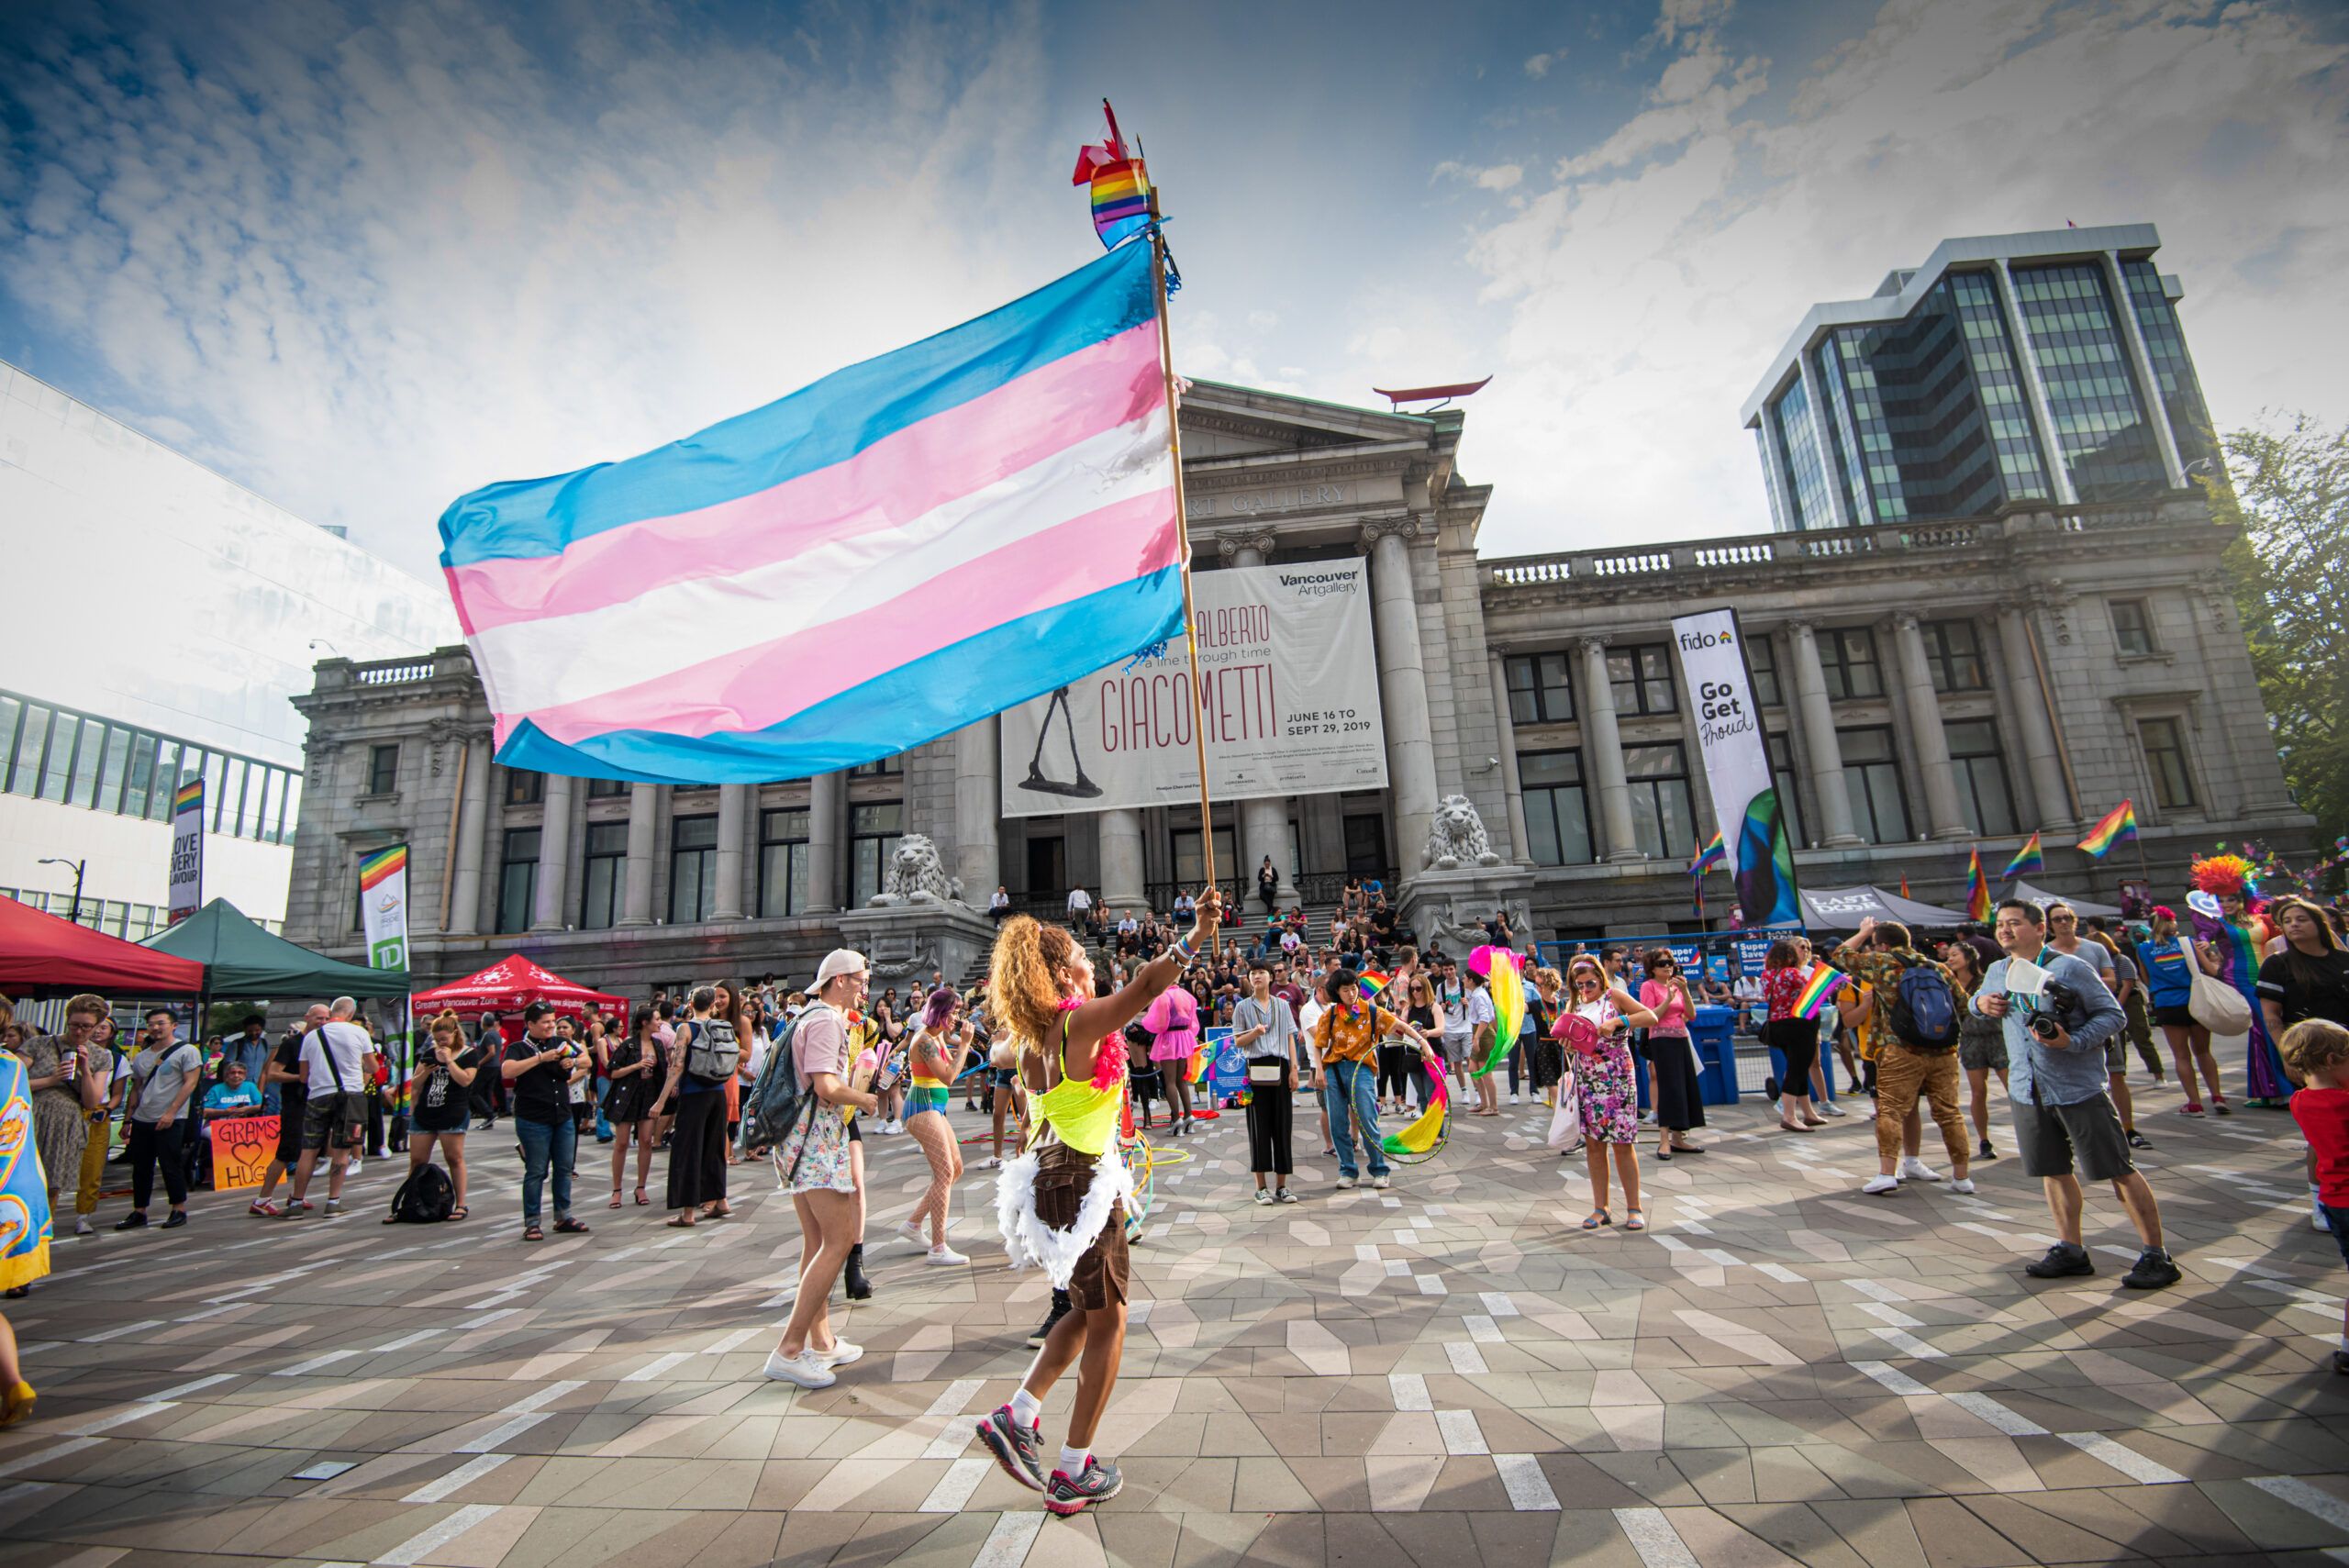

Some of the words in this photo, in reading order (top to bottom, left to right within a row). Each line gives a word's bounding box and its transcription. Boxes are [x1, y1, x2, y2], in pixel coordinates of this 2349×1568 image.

[1186, 497, 1217, 517] RT
[1231, 484, 1346, 513] GALLERY
[1279, 570, 1358, 586] Vancouver
[1297, 582, 1358, 596] Artgallery
[1197, 605, 1270, 649] ALBERTO
[1680, 631, 1716, 651] fido
[1145, 661, 1152, 669] a
[1157, 657, 1180, 667] line
[1184, 650, 1237, 665] trough
[1241, 647, 1272, 659] time
[1700, 682, 1732, 701] Go
[1100, 662, 1276, 752] GIACOMETTI
[1286, 712, 1319, 723] JUNE
[1322, 710, 1336, 720] 16
[1338, 709, 1356, 719] TO
[1701, 697, 1742, 720] Get
[1287, 725, 1319, 736] SEPT
[1322, 723, 1340, 734] 29,
[1342, 721, 1371, 732] 2019
[1700, 710, 1753, 747] Proud
[171, 833, 198, 855] OVE
[169, 869, 198, 886] LAVOUR
[1808, 893, 1873, 906] LAST
[376, 943, 403, 970] TD
[1671, 948, 1693, 957] uper
[1740, 942, 1768, 952] Super
[1741, 951, 1765, 959] Save
[1743, 964, 1766, 973] Recycl
[415, 999, 441, 1009] Greater
[441, 997, 479, 1007] Vancouver
[218, 1119, 281, 1144] GRAMS
[226, 1165, 266, 1187] HUG
